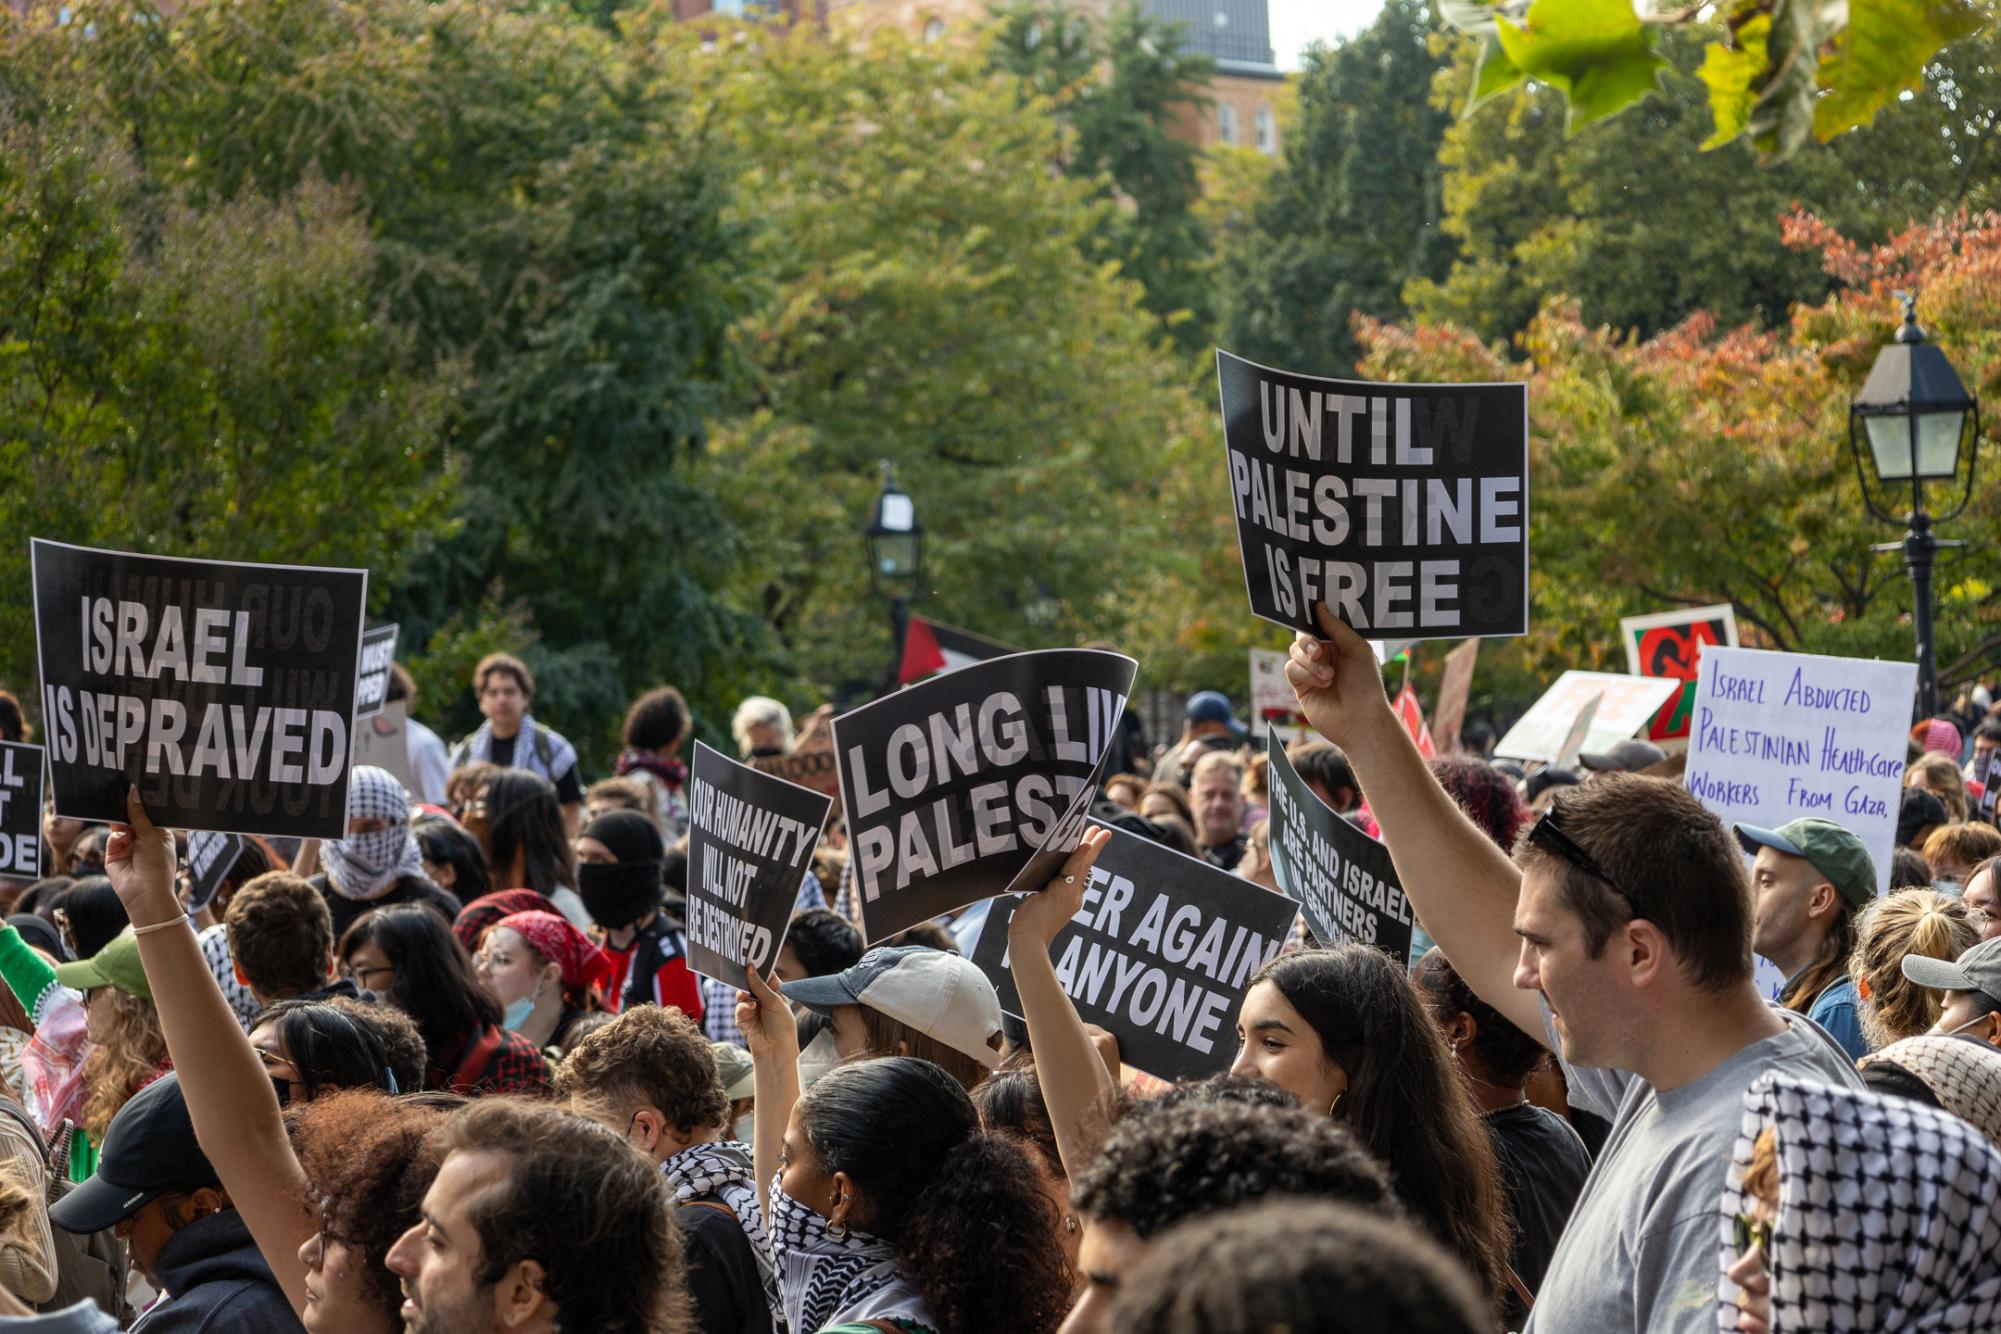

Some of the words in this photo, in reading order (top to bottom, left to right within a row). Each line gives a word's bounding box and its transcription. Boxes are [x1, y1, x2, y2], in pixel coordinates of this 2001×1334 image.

[1260, 379, 1434, 466] UNTIL
[1230, 448, 1521, 547] PALESTINE
[1264, 542, 1297, 618] IS
[1298, 556, 1461, 629] FREE
[81, 595, 264, 687] ISRAEL
[1711, 660, 1765, 704] ISRAEL
[1783, 667, 1871, 714] ABDUCTED
[46, 684, 78, 764] IS
[79, 690, 347, 786] DEPRAVED
[849, 691, 1029, 819] LONG
[1699, 707, 1811, 766] PALESTINIAN
[692, 777, 714, 835] OUR
[713, 790, 818, 867] HUMANITY
[1787, 778, 1832, 811] FROM
[702, 842, 723, 898] WILL
[724, 855, 758, 909] NOT
[1270, 760, 1288, 815] THE
[1289, 796, 1309, 847] U.S.
[1312, 830, 1339, 880] AND
[1343, 859, 1411, 926] ISRAEL
[1283, 820, 1304, 872] ARE
[1306, 850, 1378, 943] PARTNERS
[1289, 858, 1305, 898] IN
[689, 894, 702, 945] BE
[703, 901, 772, 970] DESTROYED
[1128, 893, 1283, 989] AGAIN
[1055, 935, 1231, 1055] ANYONE
